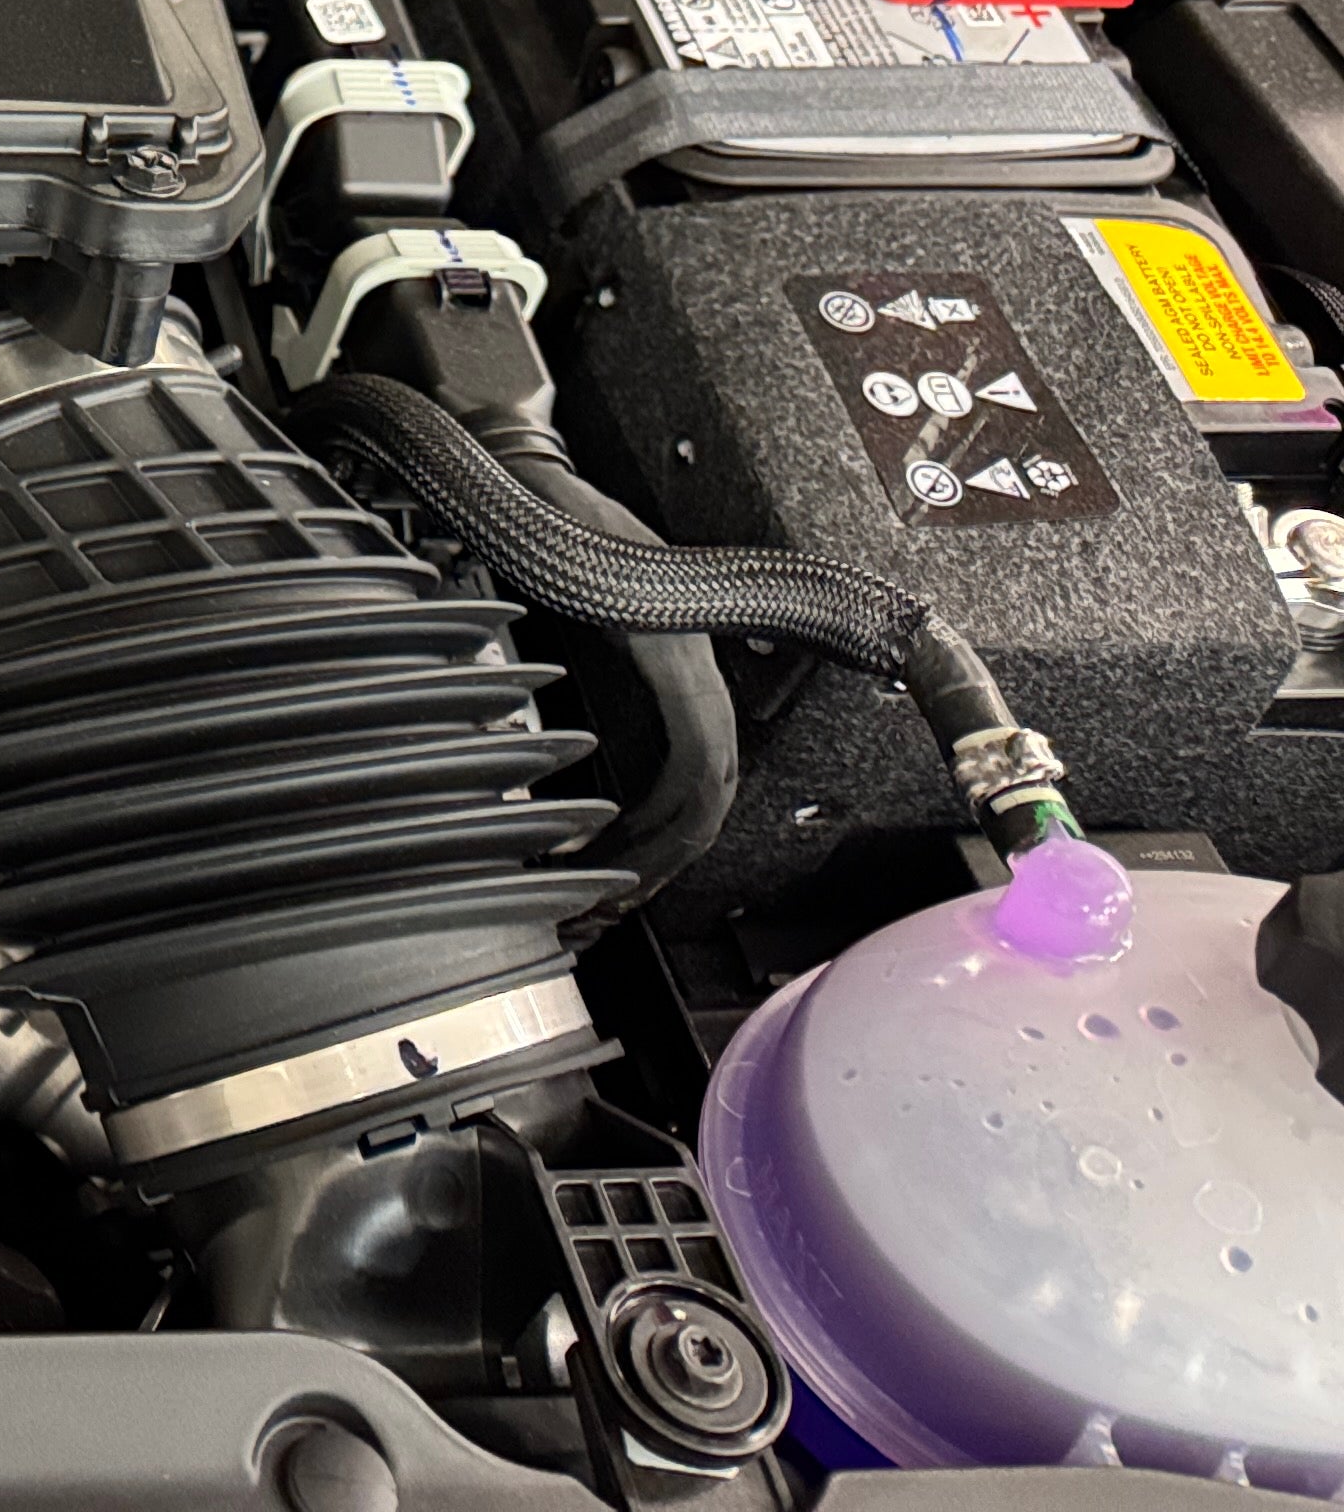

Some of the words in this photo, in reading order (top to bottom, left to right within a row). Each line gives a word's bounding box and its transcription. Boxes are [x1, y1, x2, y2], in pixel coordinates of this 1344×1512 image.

[1126, 244, 1165, 296] BATTERY
[1158, 298, 1184, 326] AGM
[1174, 264, 1242, 360] NON-SPILLABLE
[1179, 301, 1204, 330] NOT
[1227, 292, 1251, 328] VOLTS
[1176, 327, 1213, 377] SEALED
[1197, 333, 1216, 352] DO
[1262, 352, 1280, 366] TO
[1241, 343, 1270, 376] LIMIT
